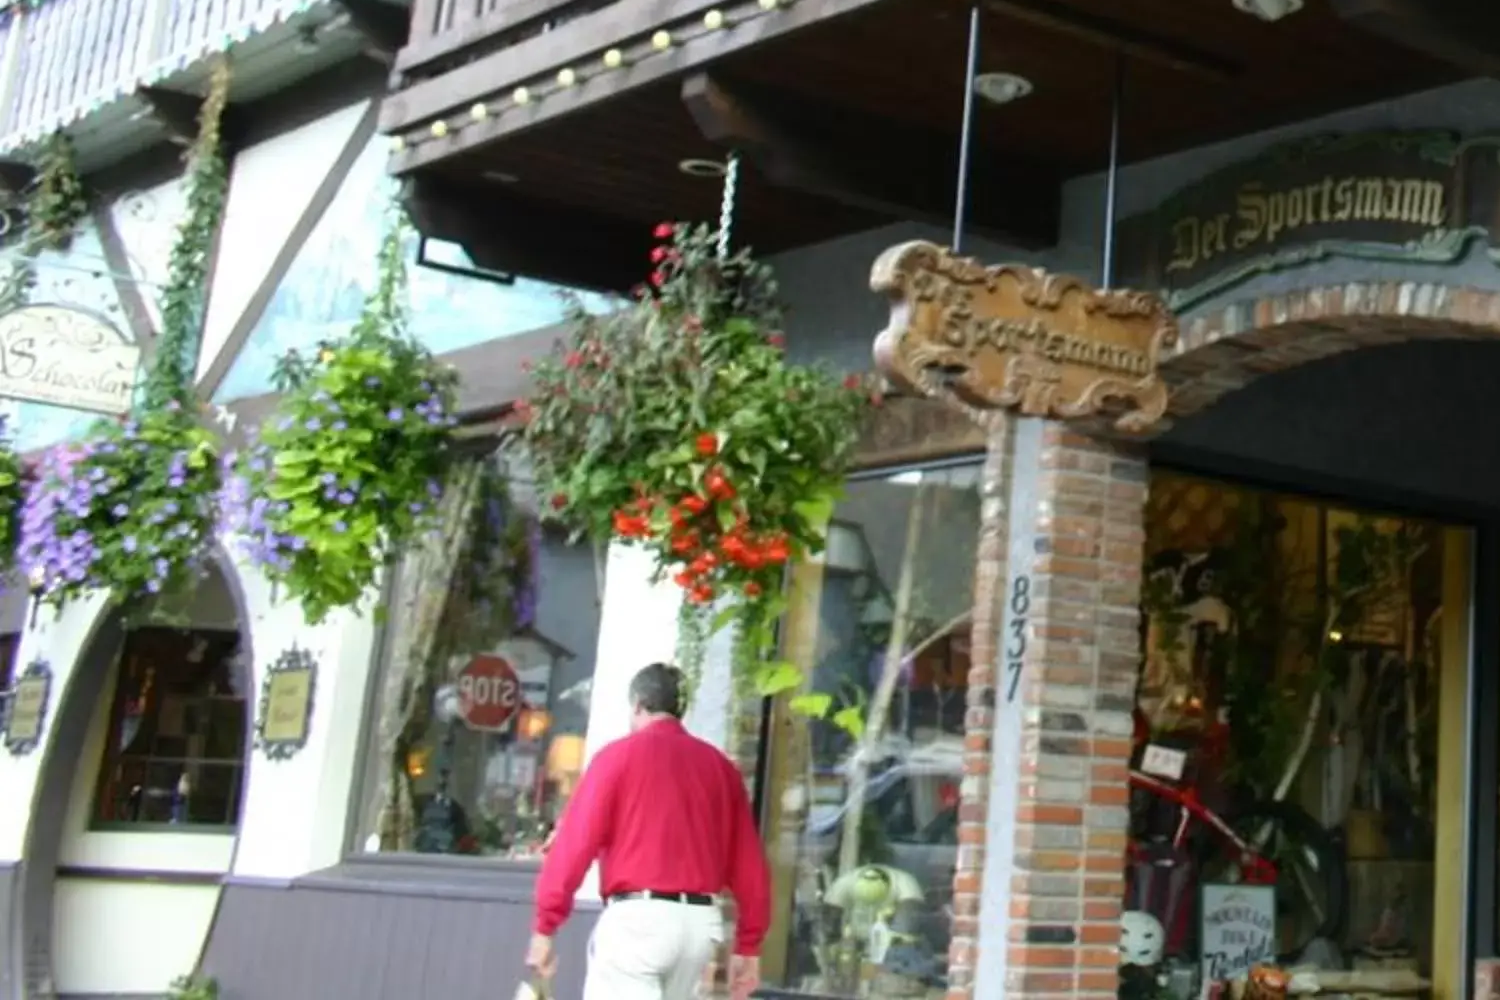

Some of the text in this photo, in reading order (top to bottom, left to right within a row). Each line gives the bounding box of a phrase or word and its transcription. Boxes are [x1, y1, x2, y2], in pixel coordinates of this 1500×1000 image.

[1167, 177, 1446, 273] Der Sportsmann
[945, 305, 1152, 376] Sportsmann
[1007, 575, 1030, 702] 837
